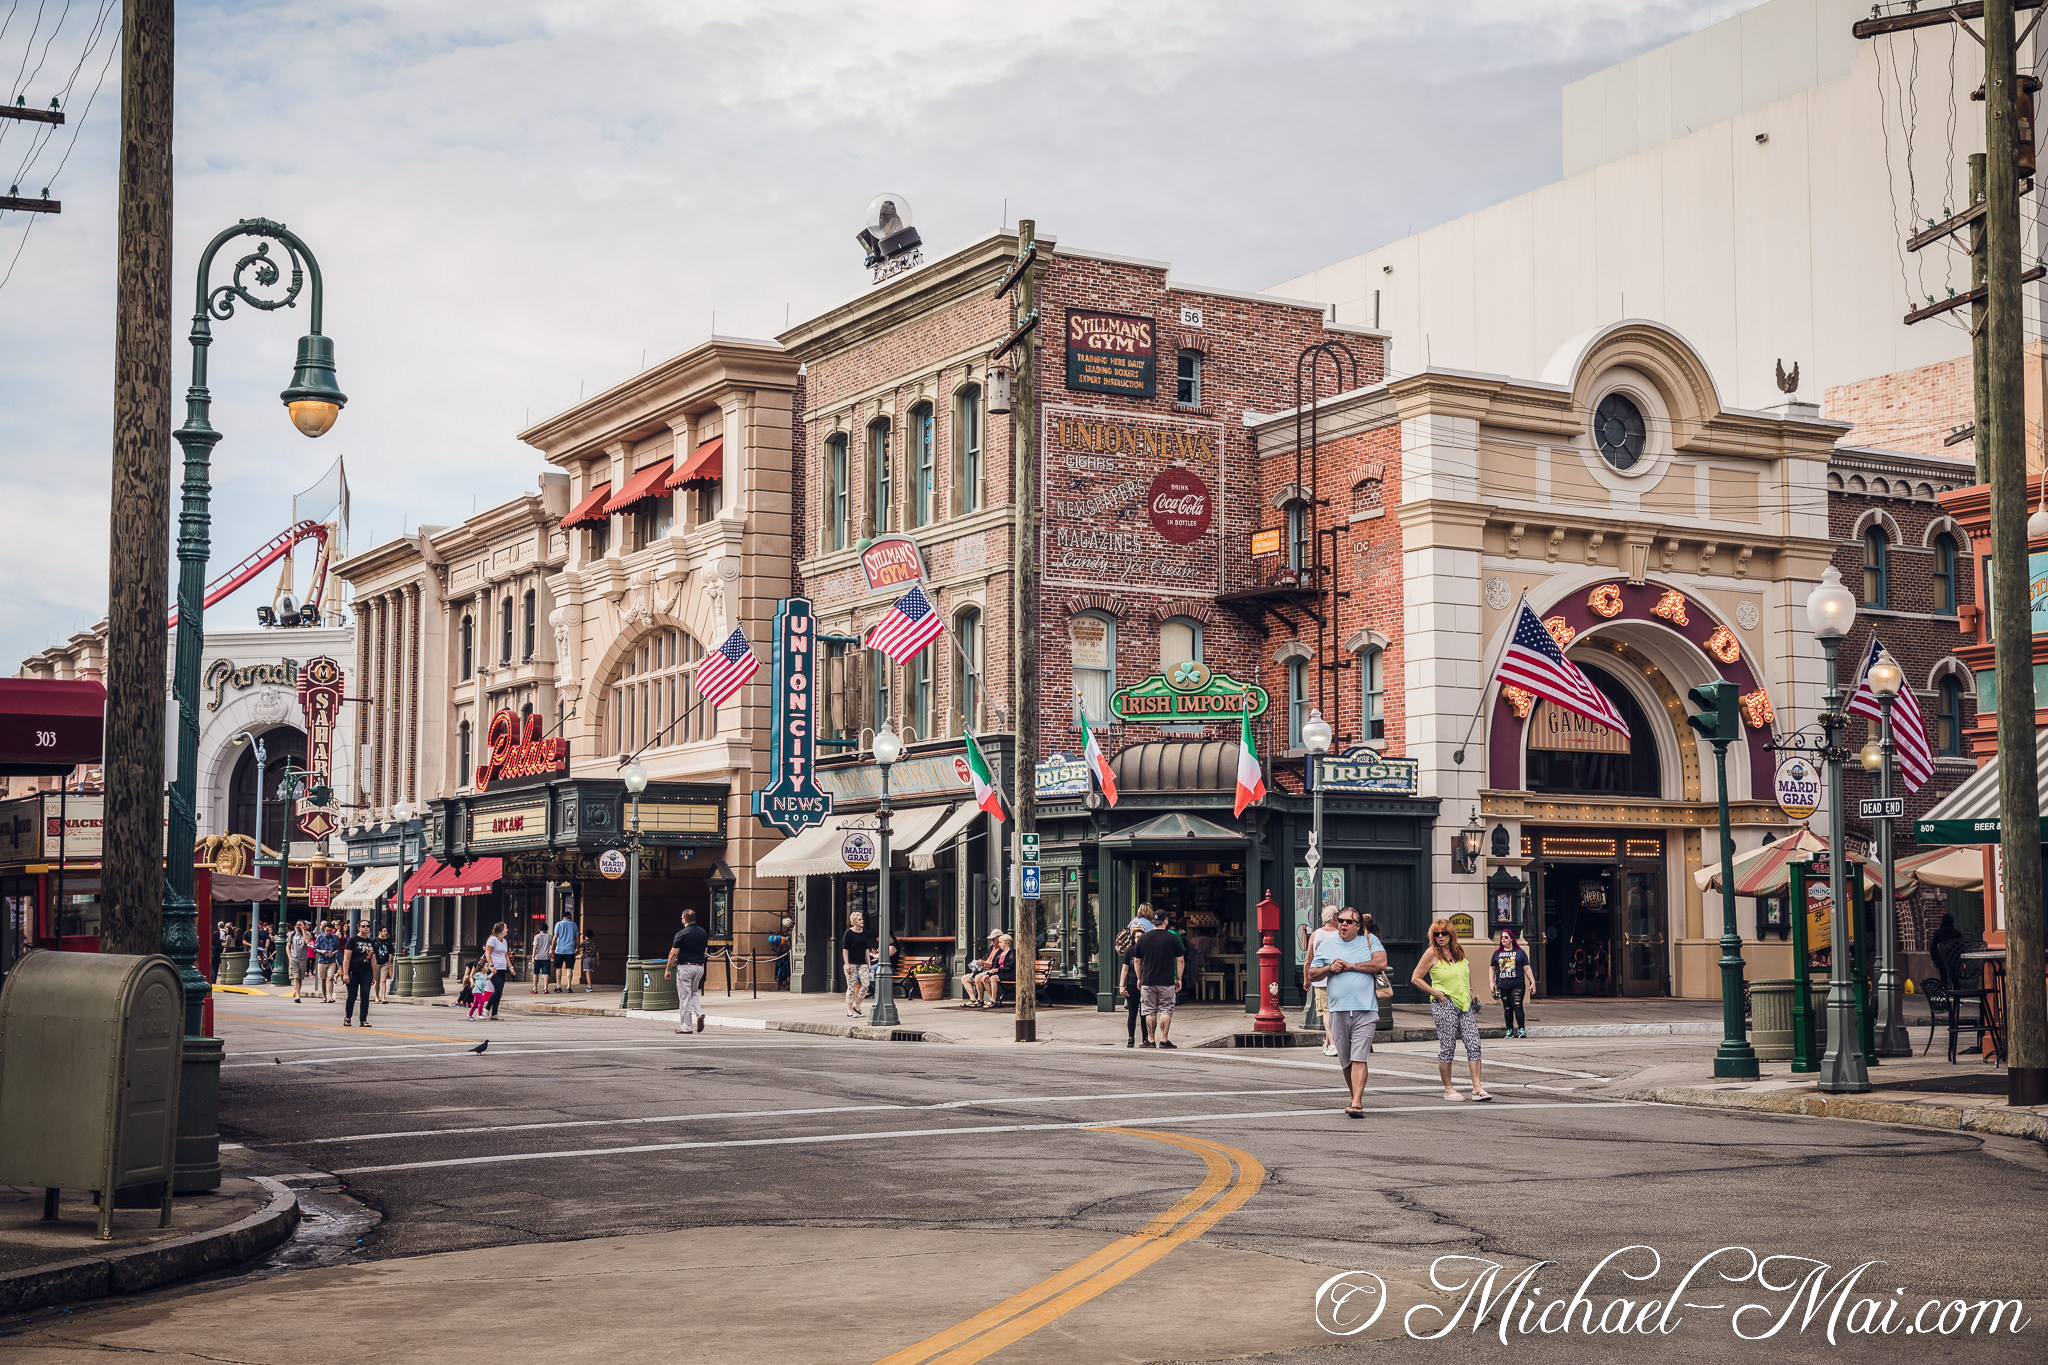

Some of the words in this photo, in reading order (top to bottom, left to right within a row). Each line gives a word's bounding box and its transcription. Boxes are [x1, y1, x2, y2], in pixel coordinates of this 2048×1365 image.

[1184, 311, 1199, 323] 56
[1070, 315, 1151, 348] STILLMAN'S
[1088, 334, 1135, 353] GYM
[1076, 353, 1108, 365] TRAINING
[1110, 357, 1126, 367] HERE
[1127, 359, 1145, 369] DAILY
[1085, 364, 1112, 376] LEADING
[1114, 367, 1139, 378] BOXERS
[1079, 374, 1102, 385] EXPERT
[1103, 376, 1144, 390] INSTRUCTION
[1056, 419, 1138, 454] UNION
[1142, 428, 1213, 463] NEWS
[1065, 453, 1116, 471] CIGARS
[1171, 483, 1189, 491] DRINK
[1056, 478, 1146, 517] NEWSPAPERS
[1153, 492, 1207, 516] Coca-Cola
[1174, 519, 1197, 528] BOTTLES
[1056, 527, 1142, 553] MAGAZINES
[864, 541, 919, 581] STILLMAN'S
[1061, 551, 1109, 578] Candy
[1120, 556, 1145, 579] Ice
[879, 562, 910, 585] GYM
[203, 657, 300, 713] Paradi
[1120, 694, 1172, 715] IRISH
[1176, 691, 1260, 714] IMPORTS
[35, 730, 57, 747] 303
[314, 693, 329, 783] SAHAR
[476, 709, 562, 793] Palace
[824, 770, 865, 794] UNION
[893, 763, 932, 790] NEWS
[930, 760, 955, 785] CO.
[1322, 763, 1410, 783] IRISH
[1778, 780, 1818, 794] MARDI
[772, 796, 824, 812] NEWS
[1782, 792, 1814, 806] GRAS
[1863, 802, 1883, 814] DEAD
[1885, 801, 1901, 813] END
[492, 815, 525, 834] ARCADE
[784, 813, 809, 822] 200
[1974, 822, 1995, 831] BEER
[844, 846, 872, 855] MARDI
[847, 854, 869, 862] GRAS
[505, 862, 548, 875] GAMES
[601, 860, 624, 868] MARDI
[1452, 918, 1472, 926] ARCADE
